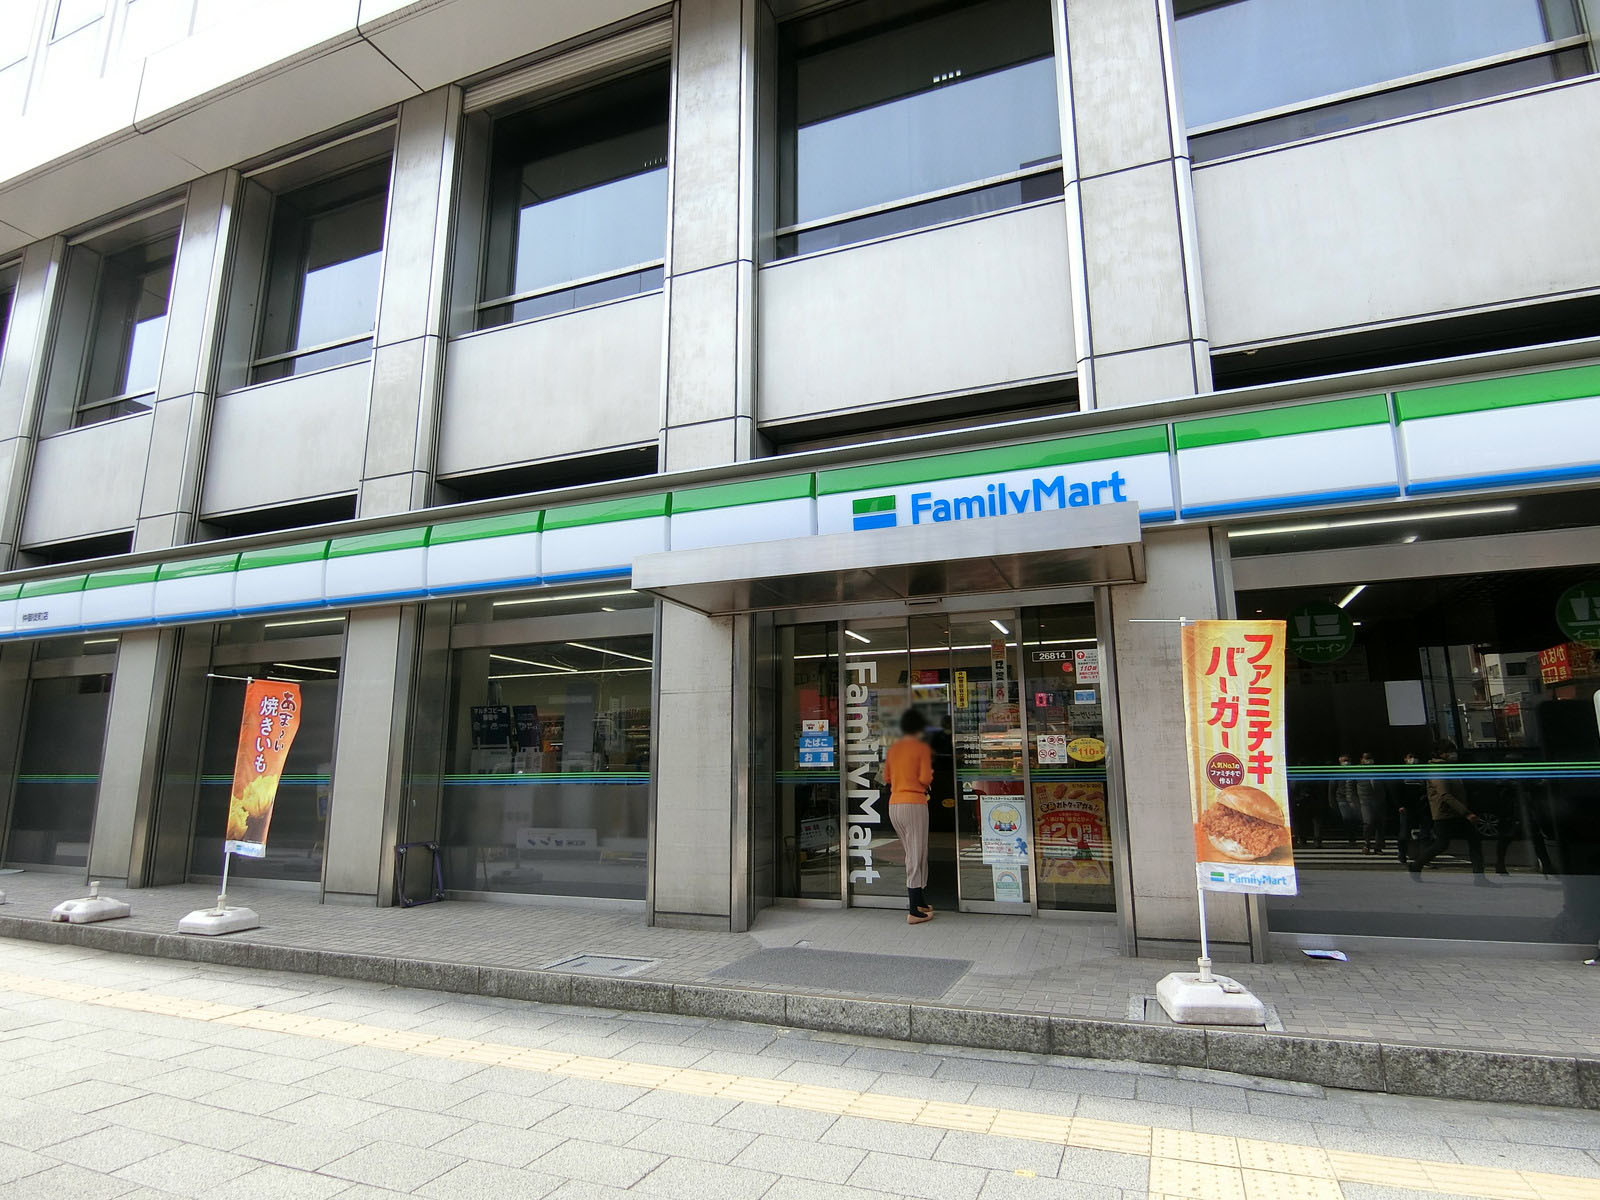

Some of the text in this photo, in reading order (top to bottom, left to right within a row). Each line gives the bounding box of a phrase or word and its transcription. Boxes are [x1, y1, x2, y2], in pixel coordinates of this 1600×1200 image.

[1040, 651, 1066, 660] 26814
[1296, 644, 1345, 654] イートイン
[1204, 647, 1245, 749] バーガー
[1243, 634, 1274, 785] ファミチキ
[254, 696, 279, 774] 焼きいも
[804, 738, 828, 748] たばこ
[1051, 822, 1082, 844] 20
[1228, 872, 1287, 886] FamilyMart
